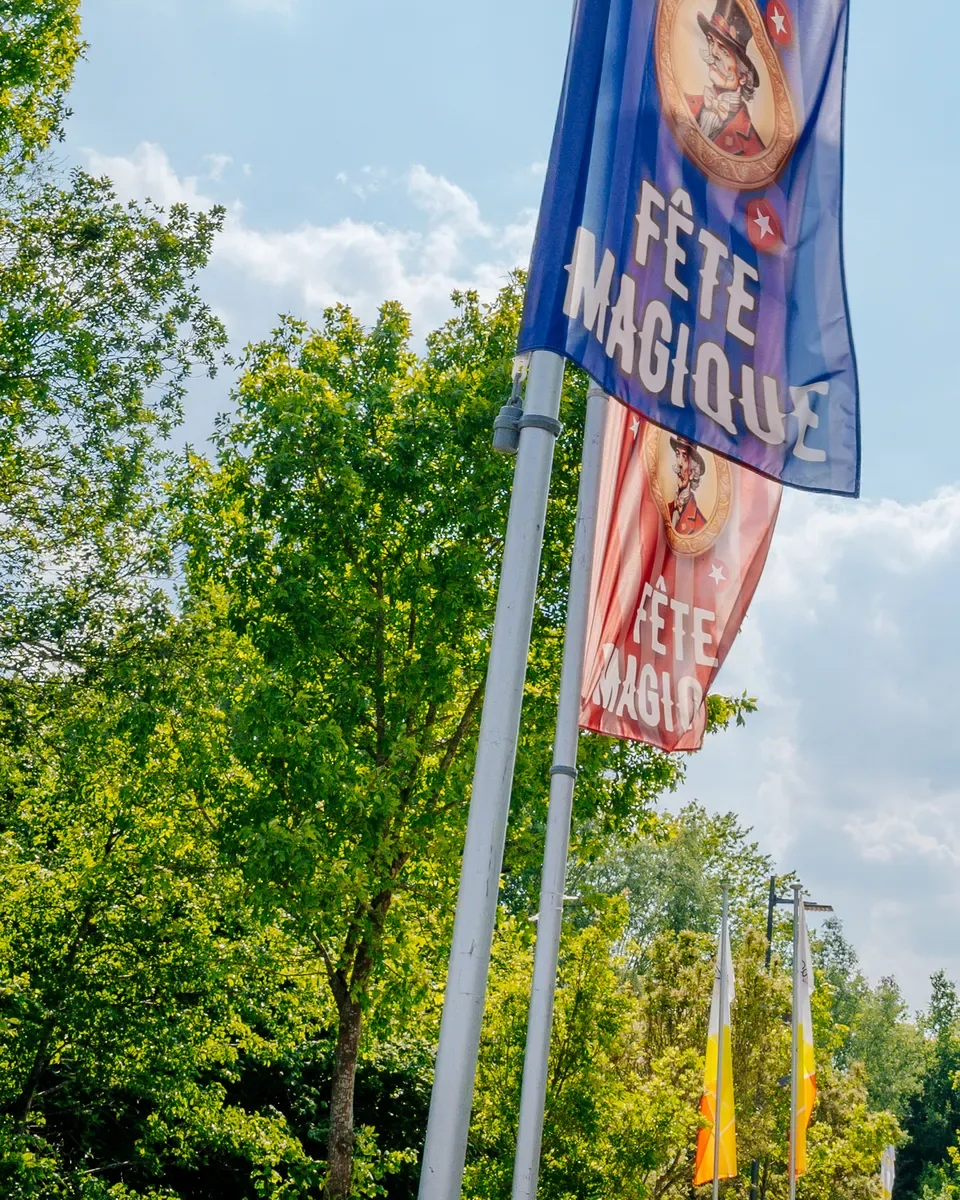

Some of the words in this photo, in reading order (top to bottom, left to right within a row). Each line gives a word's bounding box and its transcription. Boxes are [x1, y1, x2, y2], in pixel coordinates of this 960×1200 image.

[562, 226, 829, 462] MAGIQUE
[635, 179, 760, 347] FÊTE
[633, 575, 719, 668] FÊTE
